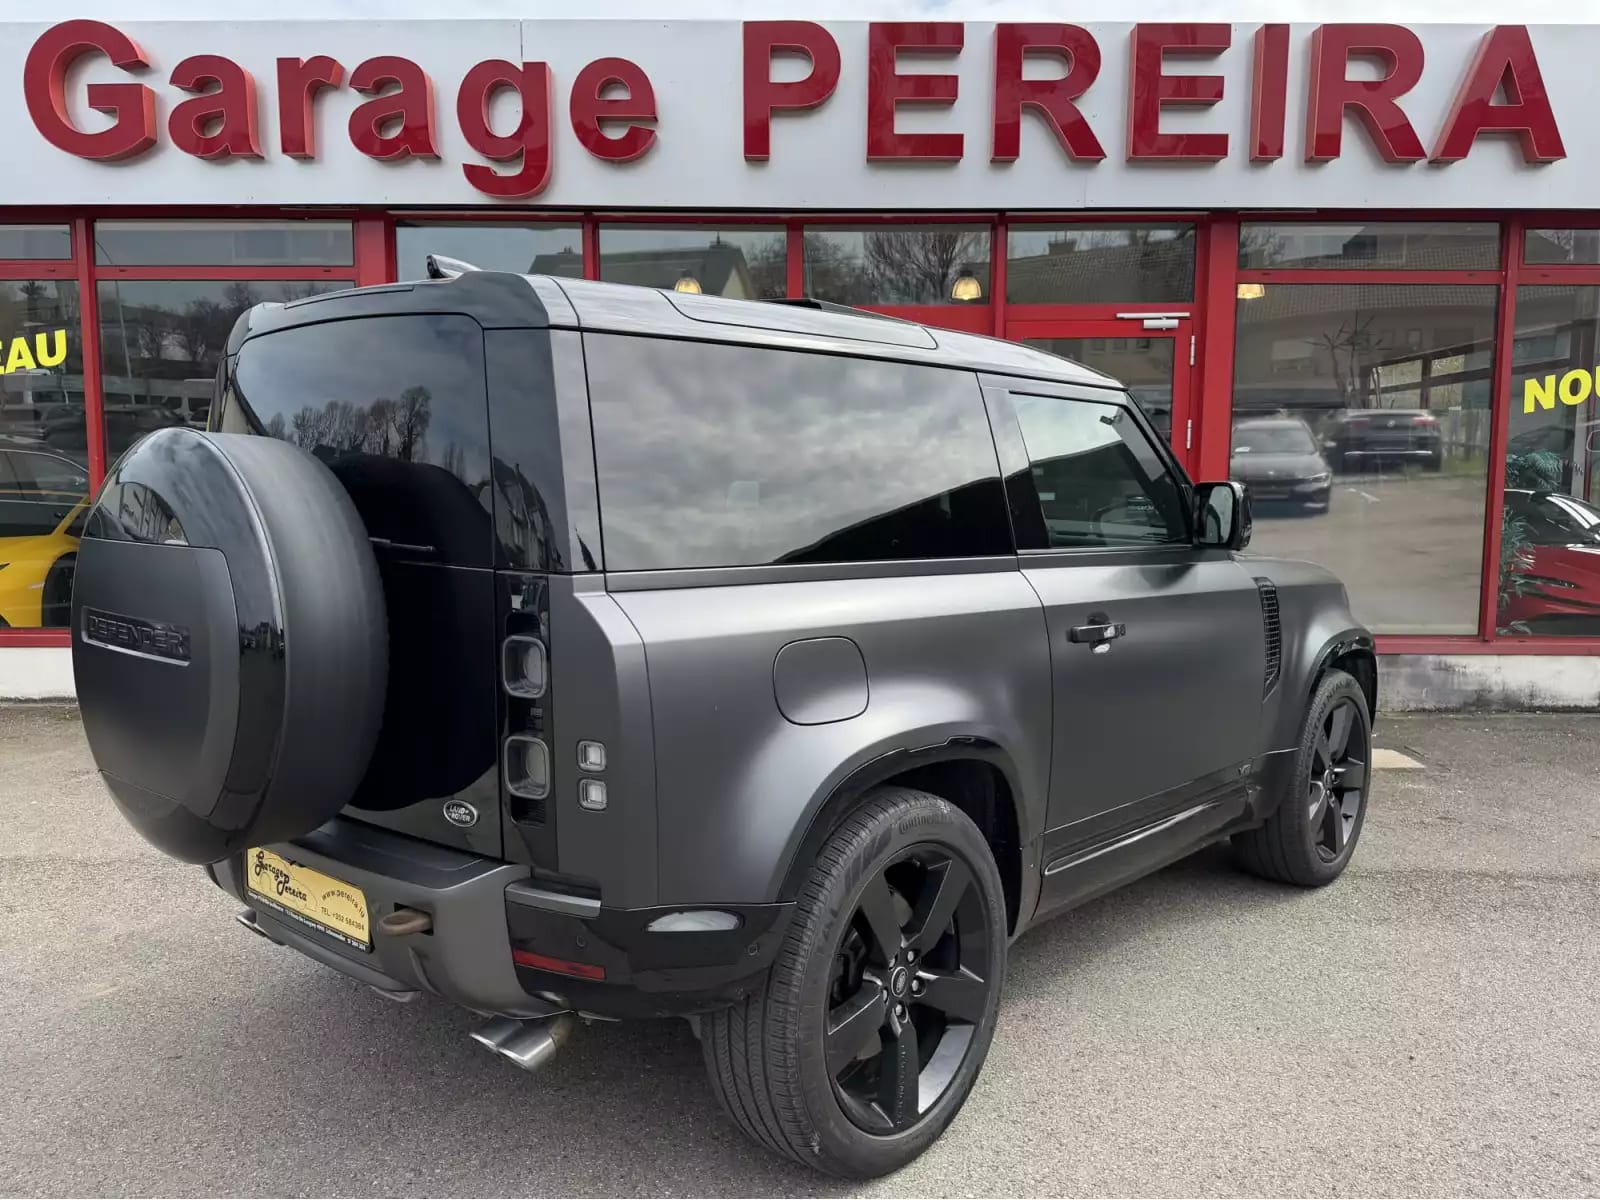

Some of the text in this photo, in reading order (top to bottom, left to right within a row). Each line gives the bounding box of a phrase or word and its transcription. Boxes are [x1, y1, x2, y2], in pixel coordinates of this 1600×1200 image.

[23, 18, 1567, 200] Garage PEREIRA
[0, 329, 67, 375] AU
[1523, 365, 1600, 414] NO
[88, 614, 184, 656] DEFENDER
[254, 850, 286, 882] Garage
[276, 873, 308, 902] Pereira
